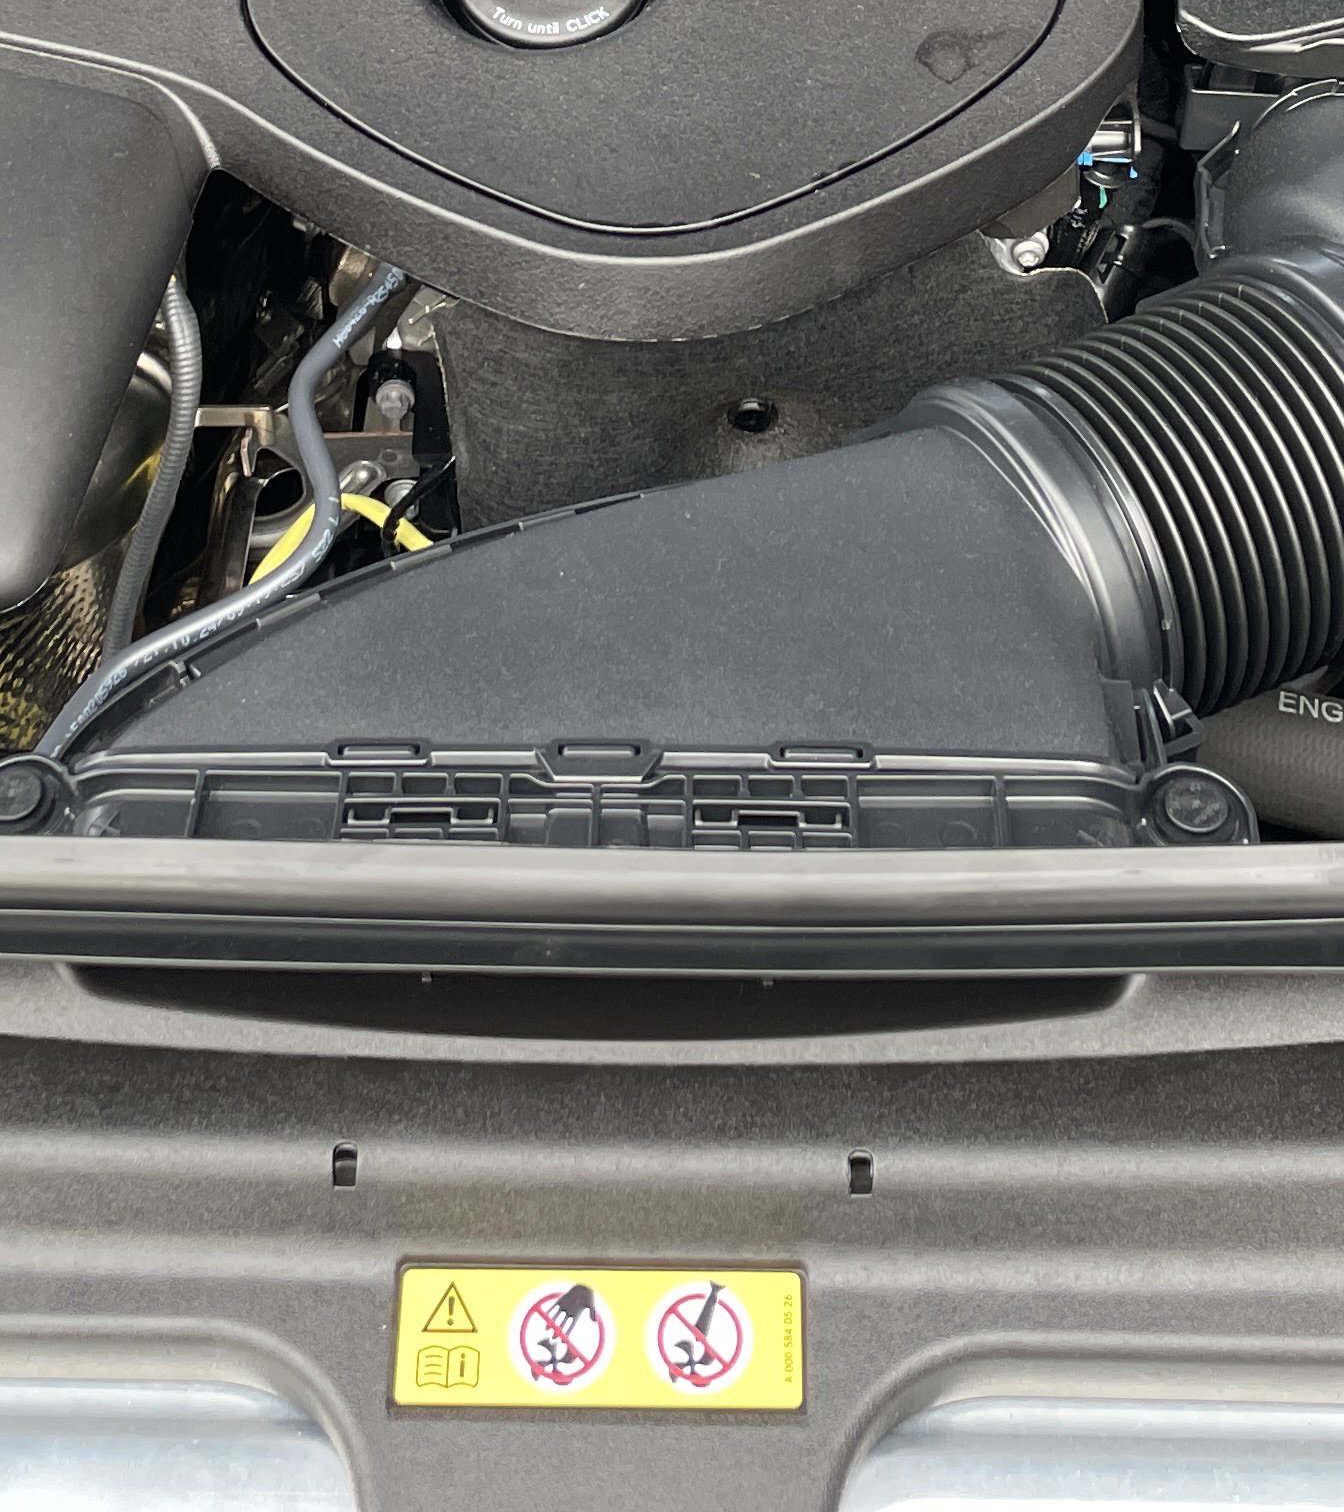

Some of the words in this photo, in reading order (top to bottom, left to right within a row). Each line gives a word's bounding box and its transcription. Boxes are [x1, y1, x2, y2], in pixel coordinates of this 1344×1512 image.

[492, 6, 523, 31] Turn
[527, 21, 560, 35] until
[565, 6, 610, 33] CLICK
[783, 1294, 793, 1308] 26
[783, 1311, 793, 1325] 05
[783, 1328, 793, 1349] 584
[784, 1351, 793, 1373] 000
[784, 1375, 792, 1383] A
